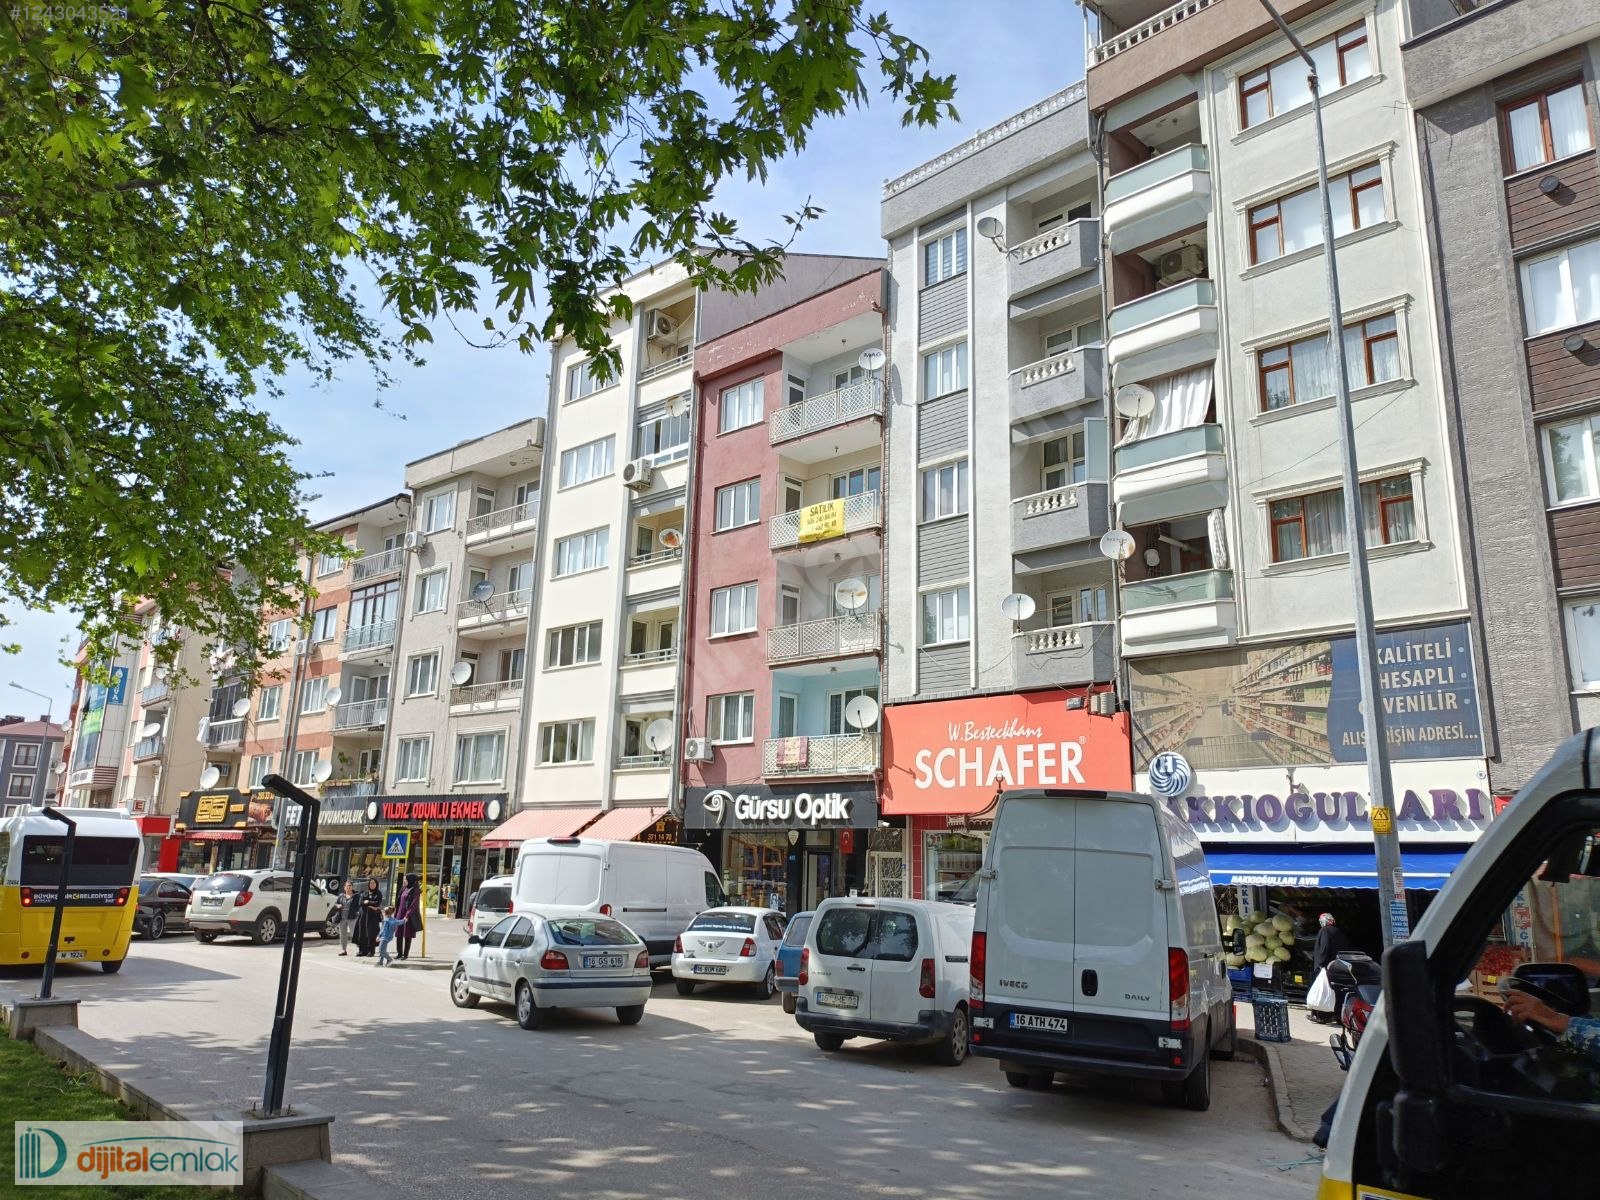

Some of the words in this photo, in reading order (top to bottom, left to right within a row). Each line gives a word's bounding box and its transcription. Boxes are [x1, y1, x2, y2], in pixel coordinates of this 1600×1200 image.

[1376, 637, 1452, 666] KALİTELİ
[1380, 667, 1454, 689] HESAPLI
[1359, 690, 1458, 714] VENİLİR
[914, 741, 1085, 789] SCHAFER
[319, 810, 365, 825] UYUMCULUK
[382, 802, 411, 819] YILDIZ
[411, 802, 449, 819] ODUNLU
[450, 801, 486, 819] EKMEK
[734, 795, 790, 820] Gürsu
[794, 793, 850, 826] Optik
[1230, 874, 1297, 886] HAKKIOĞULLARI
[1298, 876, 1319, 887] AVM
[33, 892, 73, 901] BÜYÜKŞİR
[80, 892, 114, 900] BELEDİYESİ
[1000, 979, 1028, 990] IVECO
[1125, 993, 1150, 1002] DAILY
[1016, 1014, 1026, 1025] 16
[1028, 1015, 1046, 1028] ATH
[1048, 1017, 1066, 1030] 474
